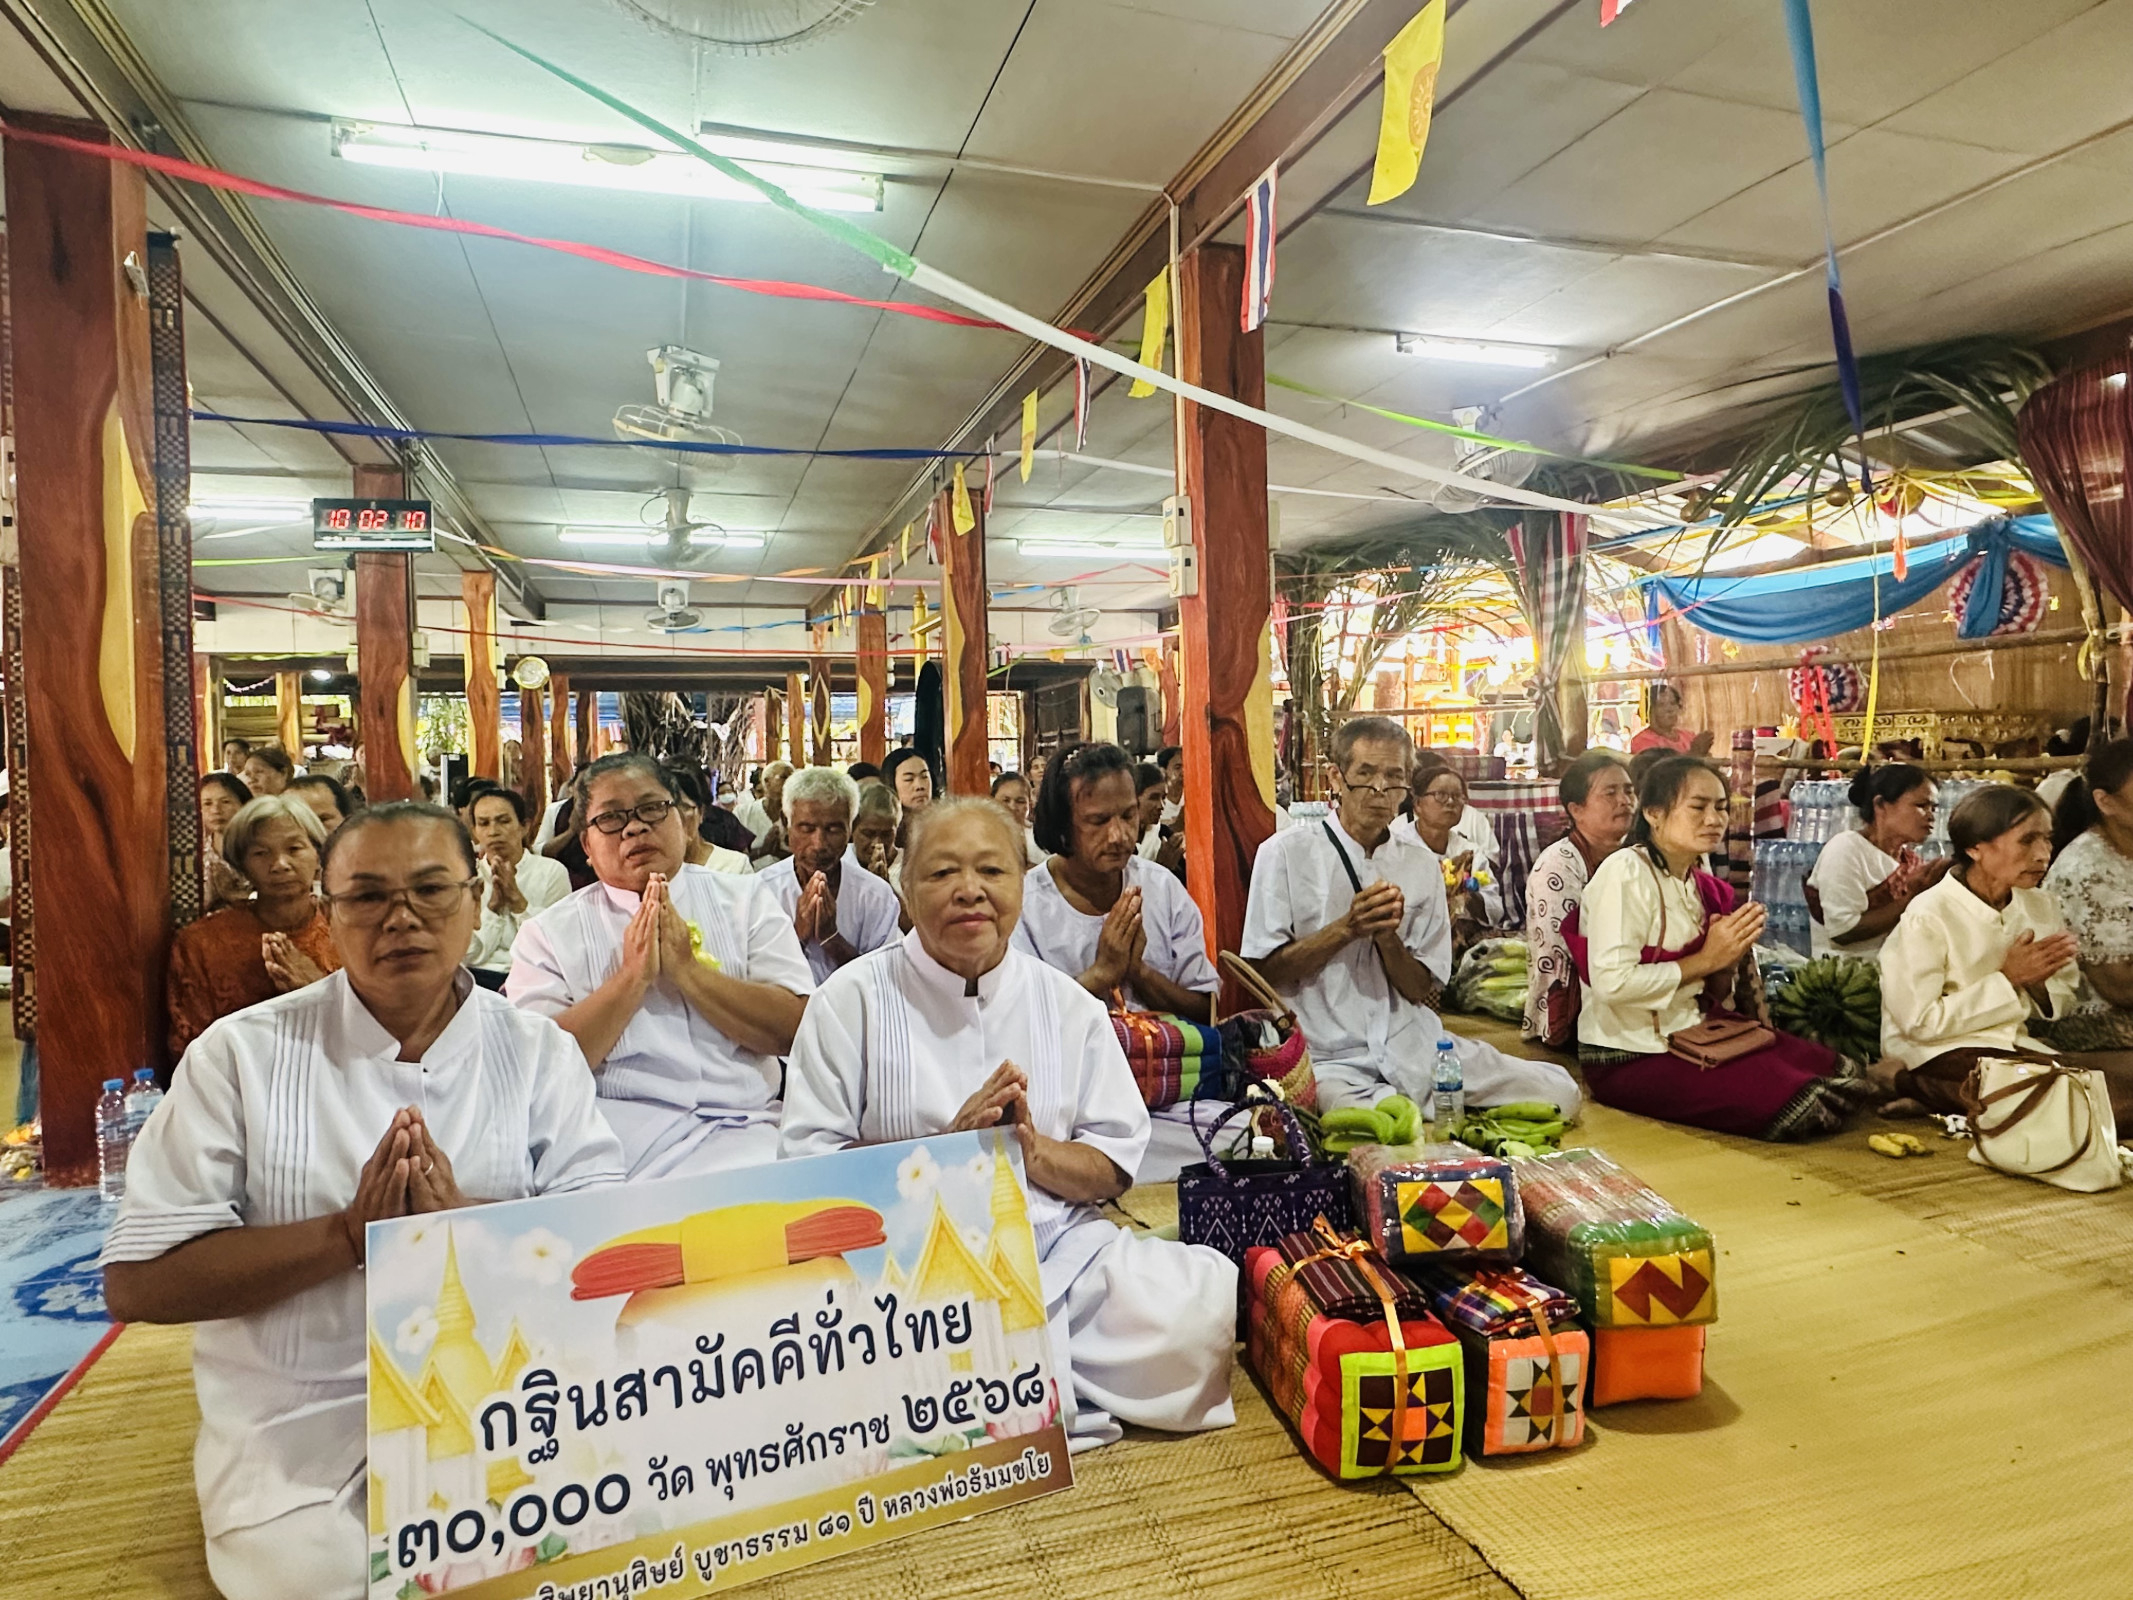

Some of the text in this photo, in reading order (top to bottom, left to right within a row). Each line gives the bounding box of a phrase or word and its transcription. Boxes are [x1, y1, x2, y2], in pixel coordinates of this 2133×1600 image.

[329, 508, 426, 531] 10 02 10
[480, 1289, 973, 1464] กฐินสามัคคีทั่วไทย
[398, 1363, 1046, 1568] ๓๐,๐๐๐ วัด พุทธศักราช ๒๕๖๘
[695, 1523, 809, 1582] บูชาธรรม
[818, 1514, 850, 1537] ๘๑
[858, 1495, 875, 1524] ปี
[883, 1450, 1050, 1518] หลวงพ่อธัมมชโย
